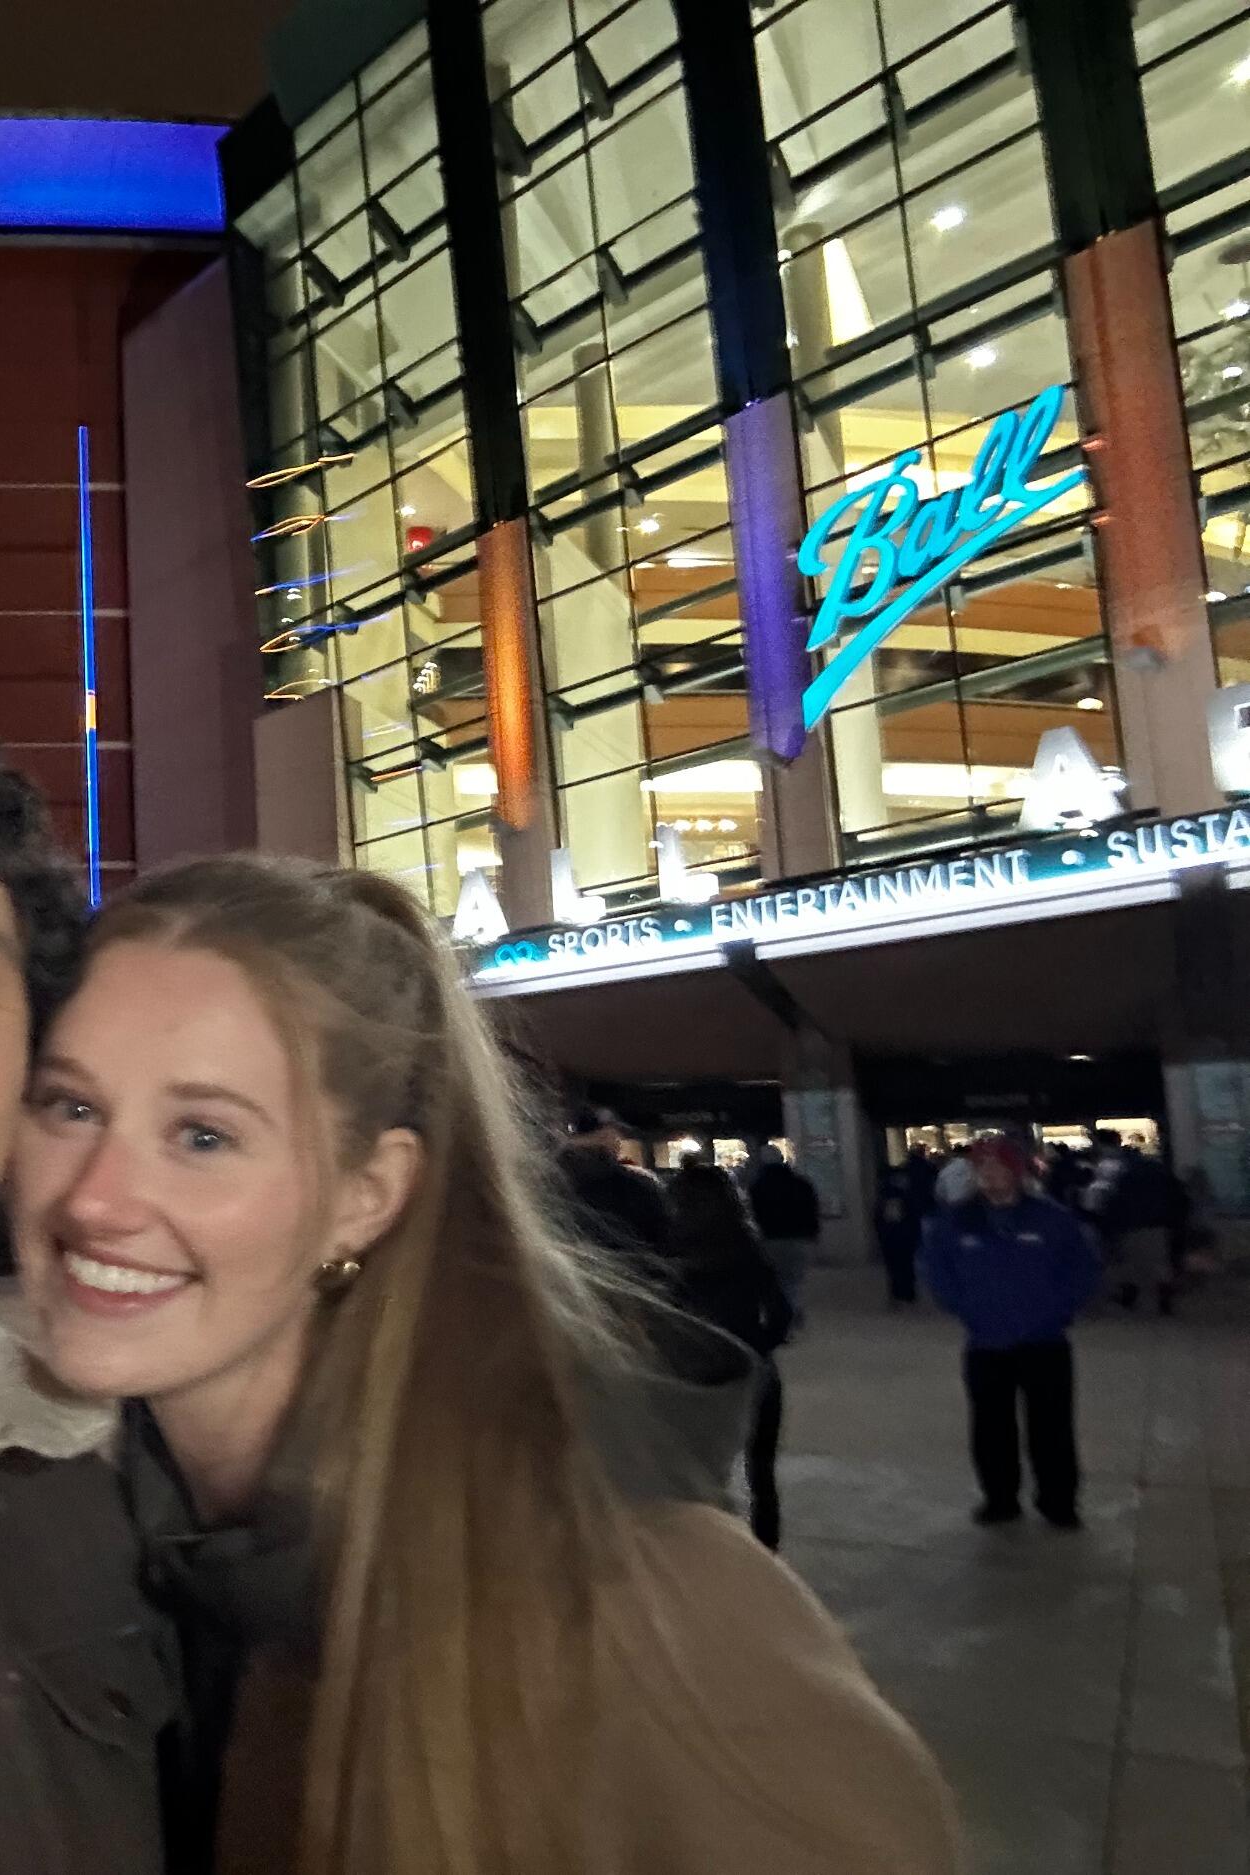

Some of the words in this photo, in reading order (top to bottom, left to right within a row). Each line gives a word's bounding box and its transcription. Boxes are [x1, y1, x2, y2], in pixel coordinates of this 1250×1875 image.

[798, 385, 1088, 732] Ball
[547, 916, 661, 962] SPORTS
[710, 848, 1029, 937] ENTERTAINMENT
